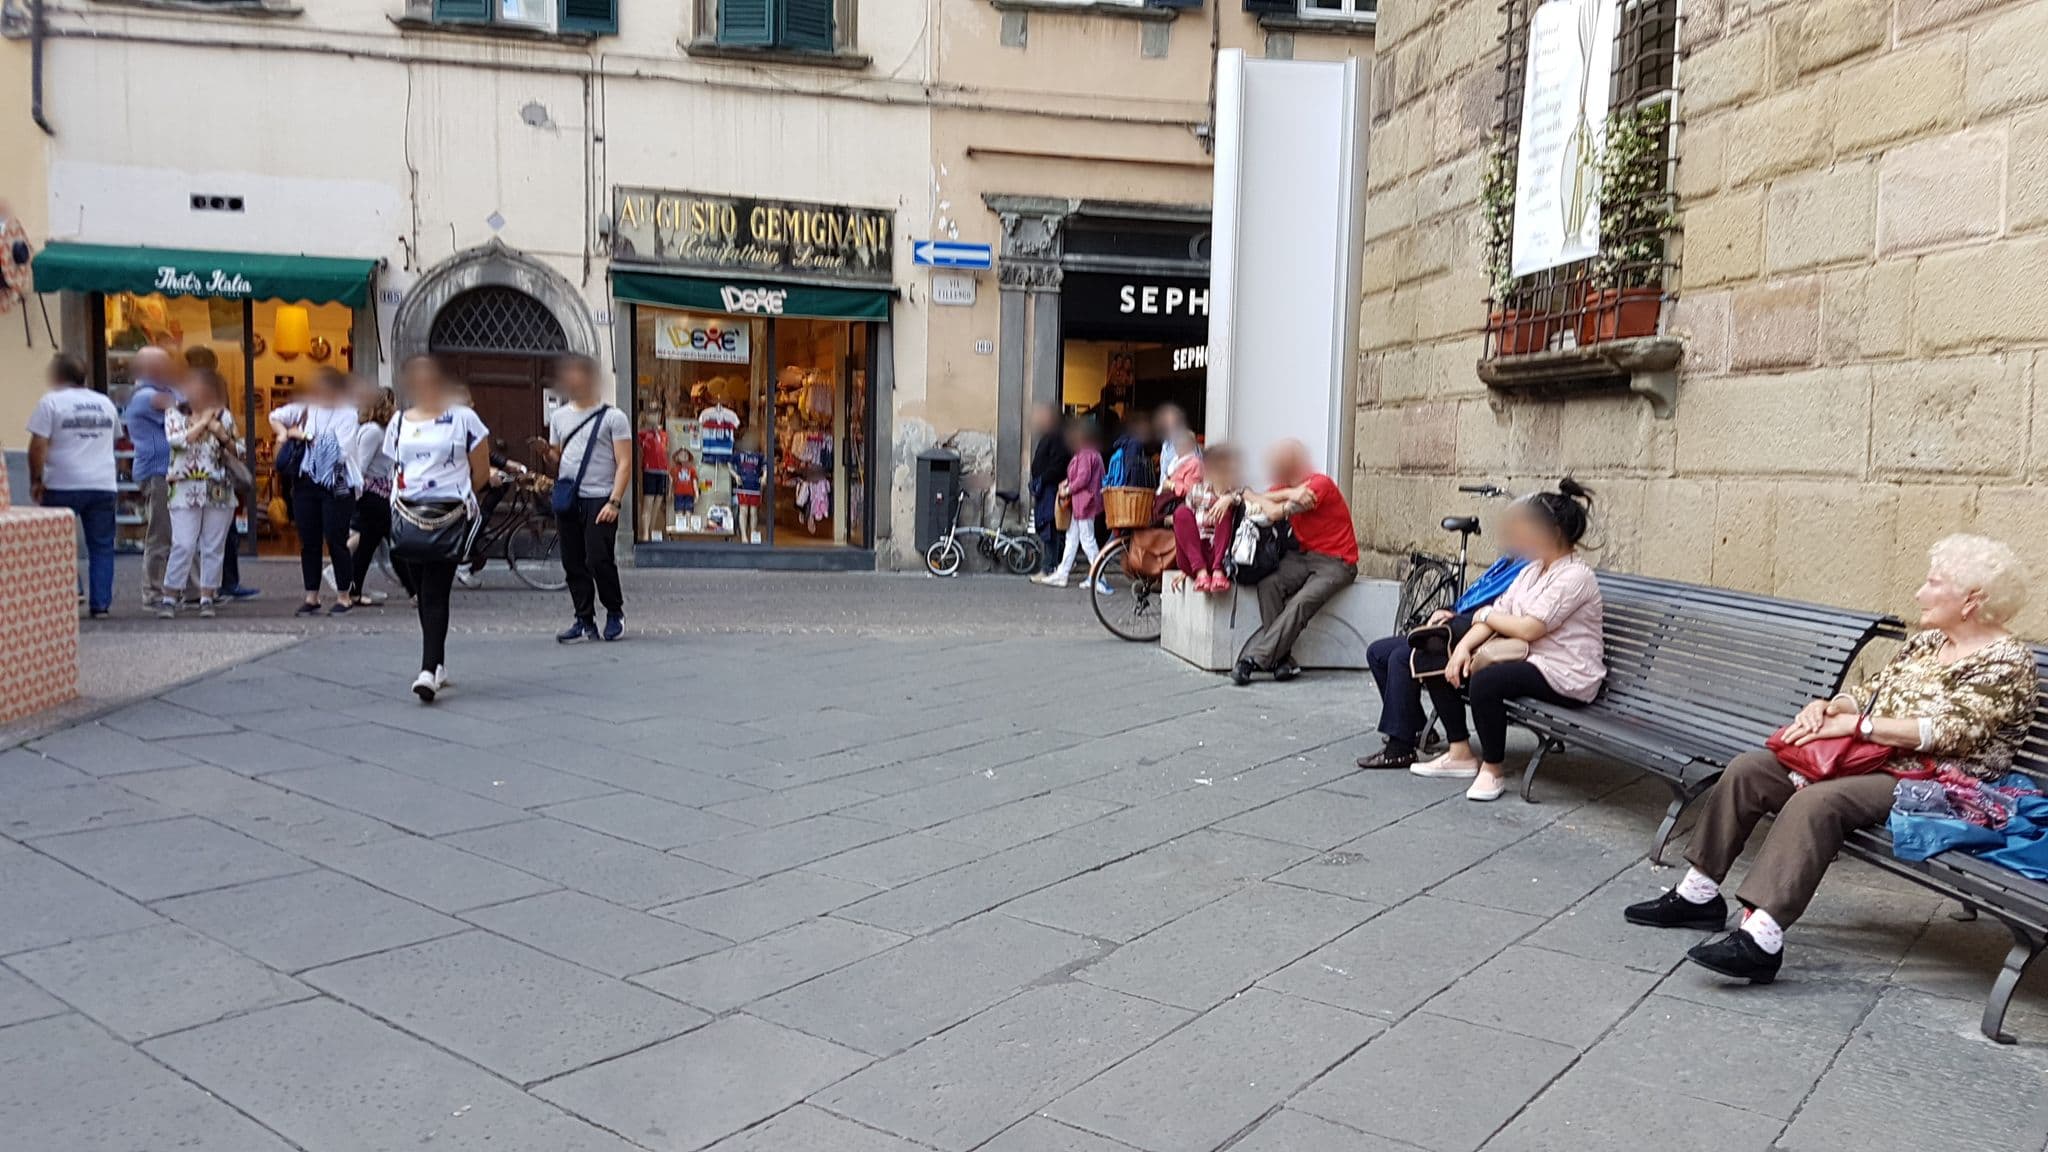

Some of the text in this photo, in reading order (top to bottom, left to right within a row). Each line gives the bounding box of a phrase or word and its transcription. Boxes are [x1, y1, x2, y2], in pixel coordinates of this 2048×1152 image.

[618, 195, 889, 250] AUGUSTO GEMIGNANI
[154, 266, 202, 290] That's
[205, 268, 252, 293] Italia
